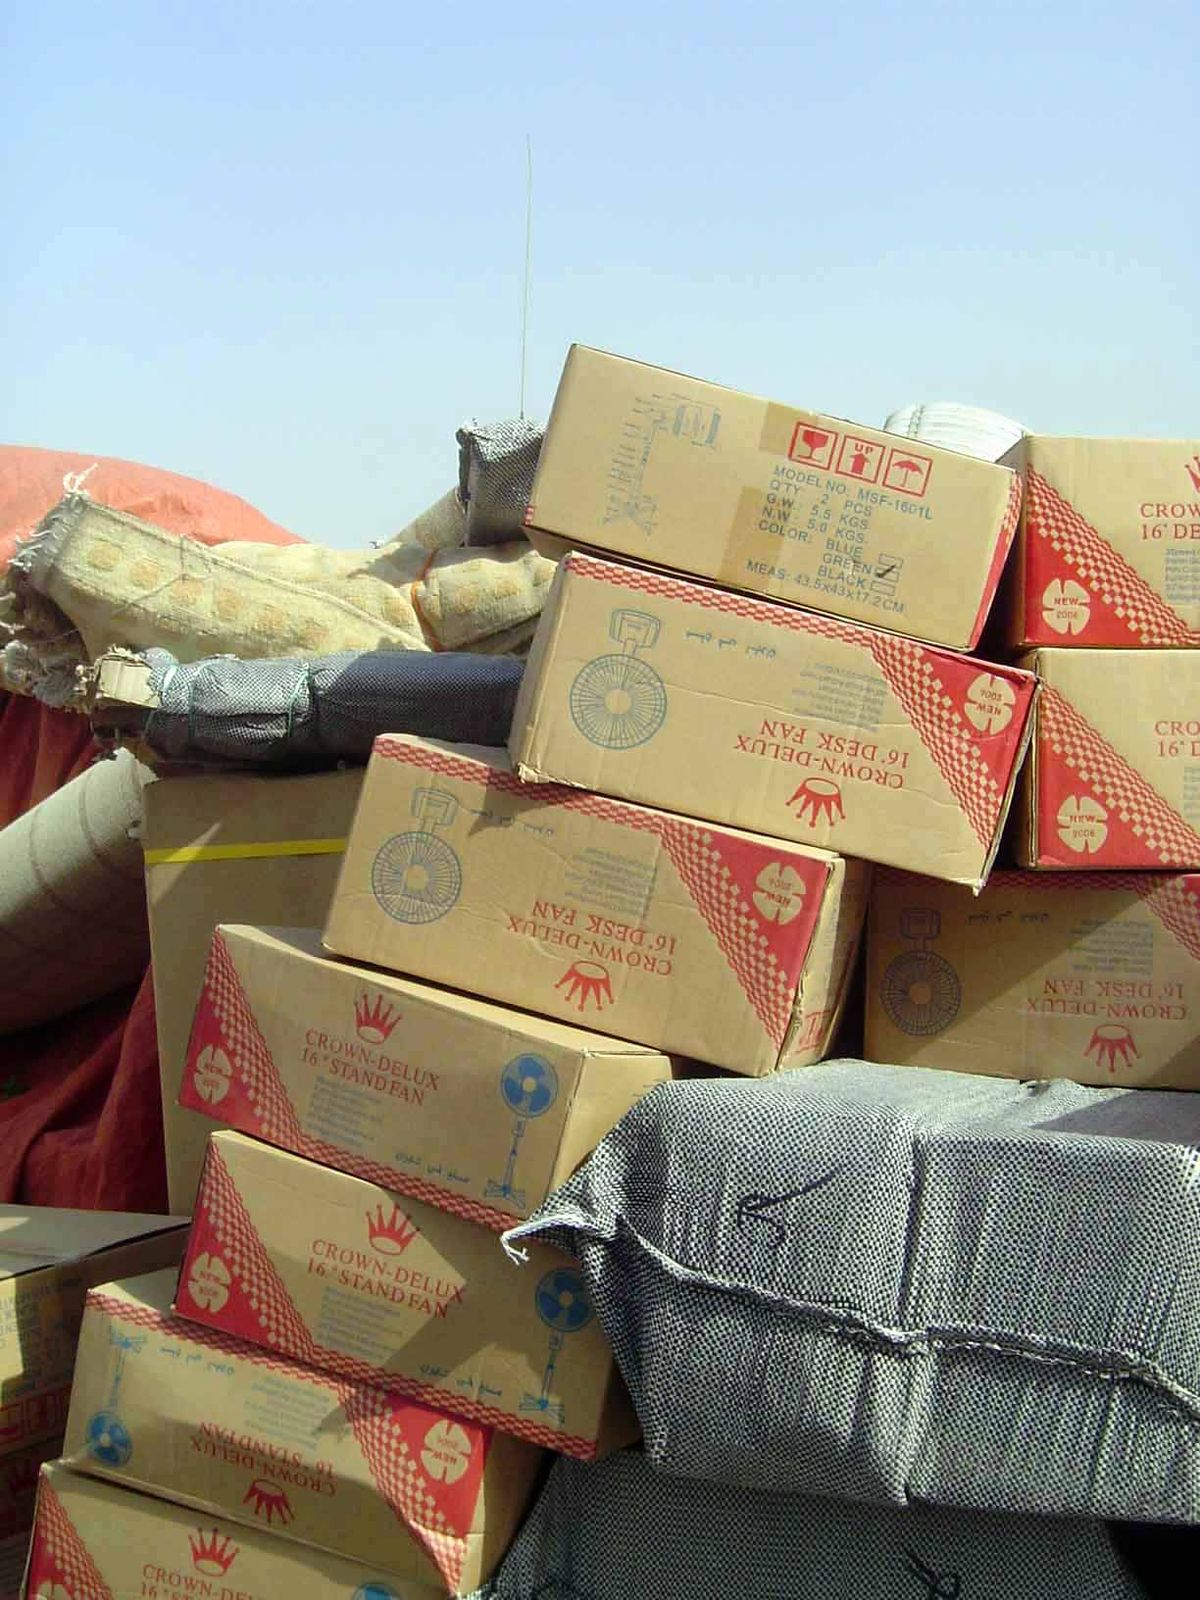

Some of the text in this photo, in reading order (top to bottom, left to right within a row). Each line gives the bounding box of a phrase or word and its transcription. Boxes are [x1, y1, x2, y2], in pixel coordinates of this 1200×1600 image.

[854, 442, 873, 454] UP
[773, 465, 821, 489] MODEL
[820, 493, 829, 505] 2
[844, 499, 873, 517] PCS
[807, 518, 827, 533] 5.0
[825, 538, 864, 559] BLUE
[822, 552, 873, 575] GREEN
[817, 565, 866, 589] BLACK
[1053, 597, 1079, 606] NEW
[975, 703, 1002, 716] NEW
[760, 719, 807, 745] FAN
[816, 732, 878, 761] DESK
[733, 734, 904, 789] CROWN-DELUX
[1069, 815, 1096, 824] NEW
[532, 900, 577, 926] FAN
[586, 913, 646, 946] DESK
[506, 916, 672, 976] CROWN-DELUX
[1043, 978, 1084, 996] FAN
[1096, 979, 1153, 998] DESK
[1026, 997, 1188, 1020] CROWN-DELUX
[305, 1028, 440, 1090] CROWN-DELUX
[312, 1239, 465, 1305] CROWN-DELUX
